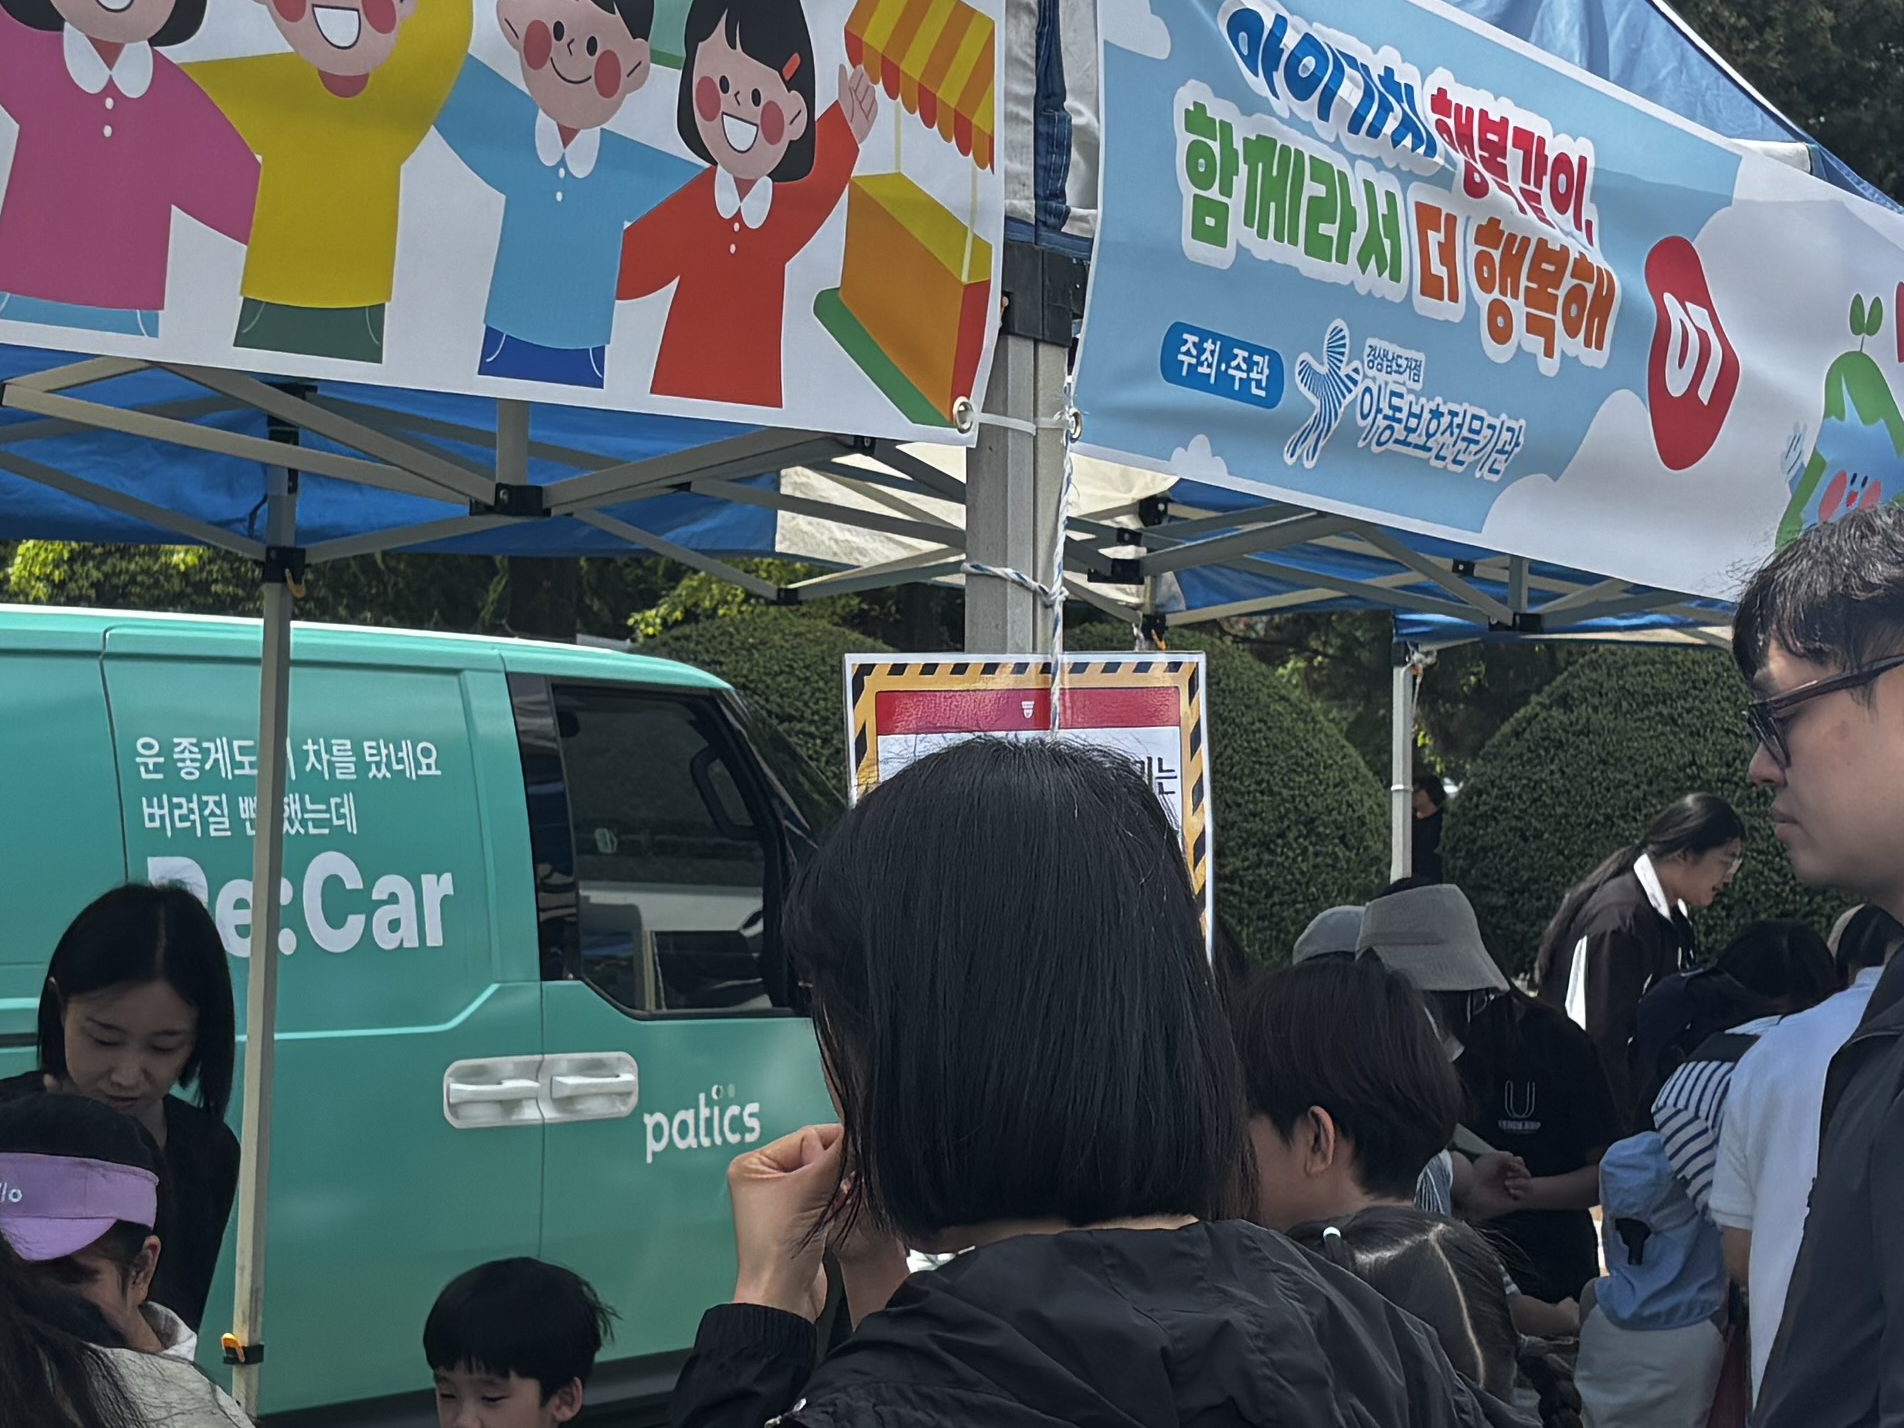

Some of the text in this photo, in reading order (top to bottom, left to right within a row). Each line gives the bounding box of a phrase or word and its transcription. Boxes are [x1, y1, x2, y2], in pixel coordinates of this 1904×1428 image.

[1226, 7, 1438, 159] 아이가치
[1183, 101, 1617, 360] 함께라서 더 행복해
[1177, 333, 1270, 398] 주최·주관
[1359, 383, 1524, 476] 아동보호전문기관
[135, 737, 165, 780] 운
[172, 737, 258, 780] 좋게도
[302, 737, 357, 780] 차를
[363, 738, 442, 780] 탔네요
[141, 793, 232, 839] 버려질
[643, 1084, 762, 1164] patics
